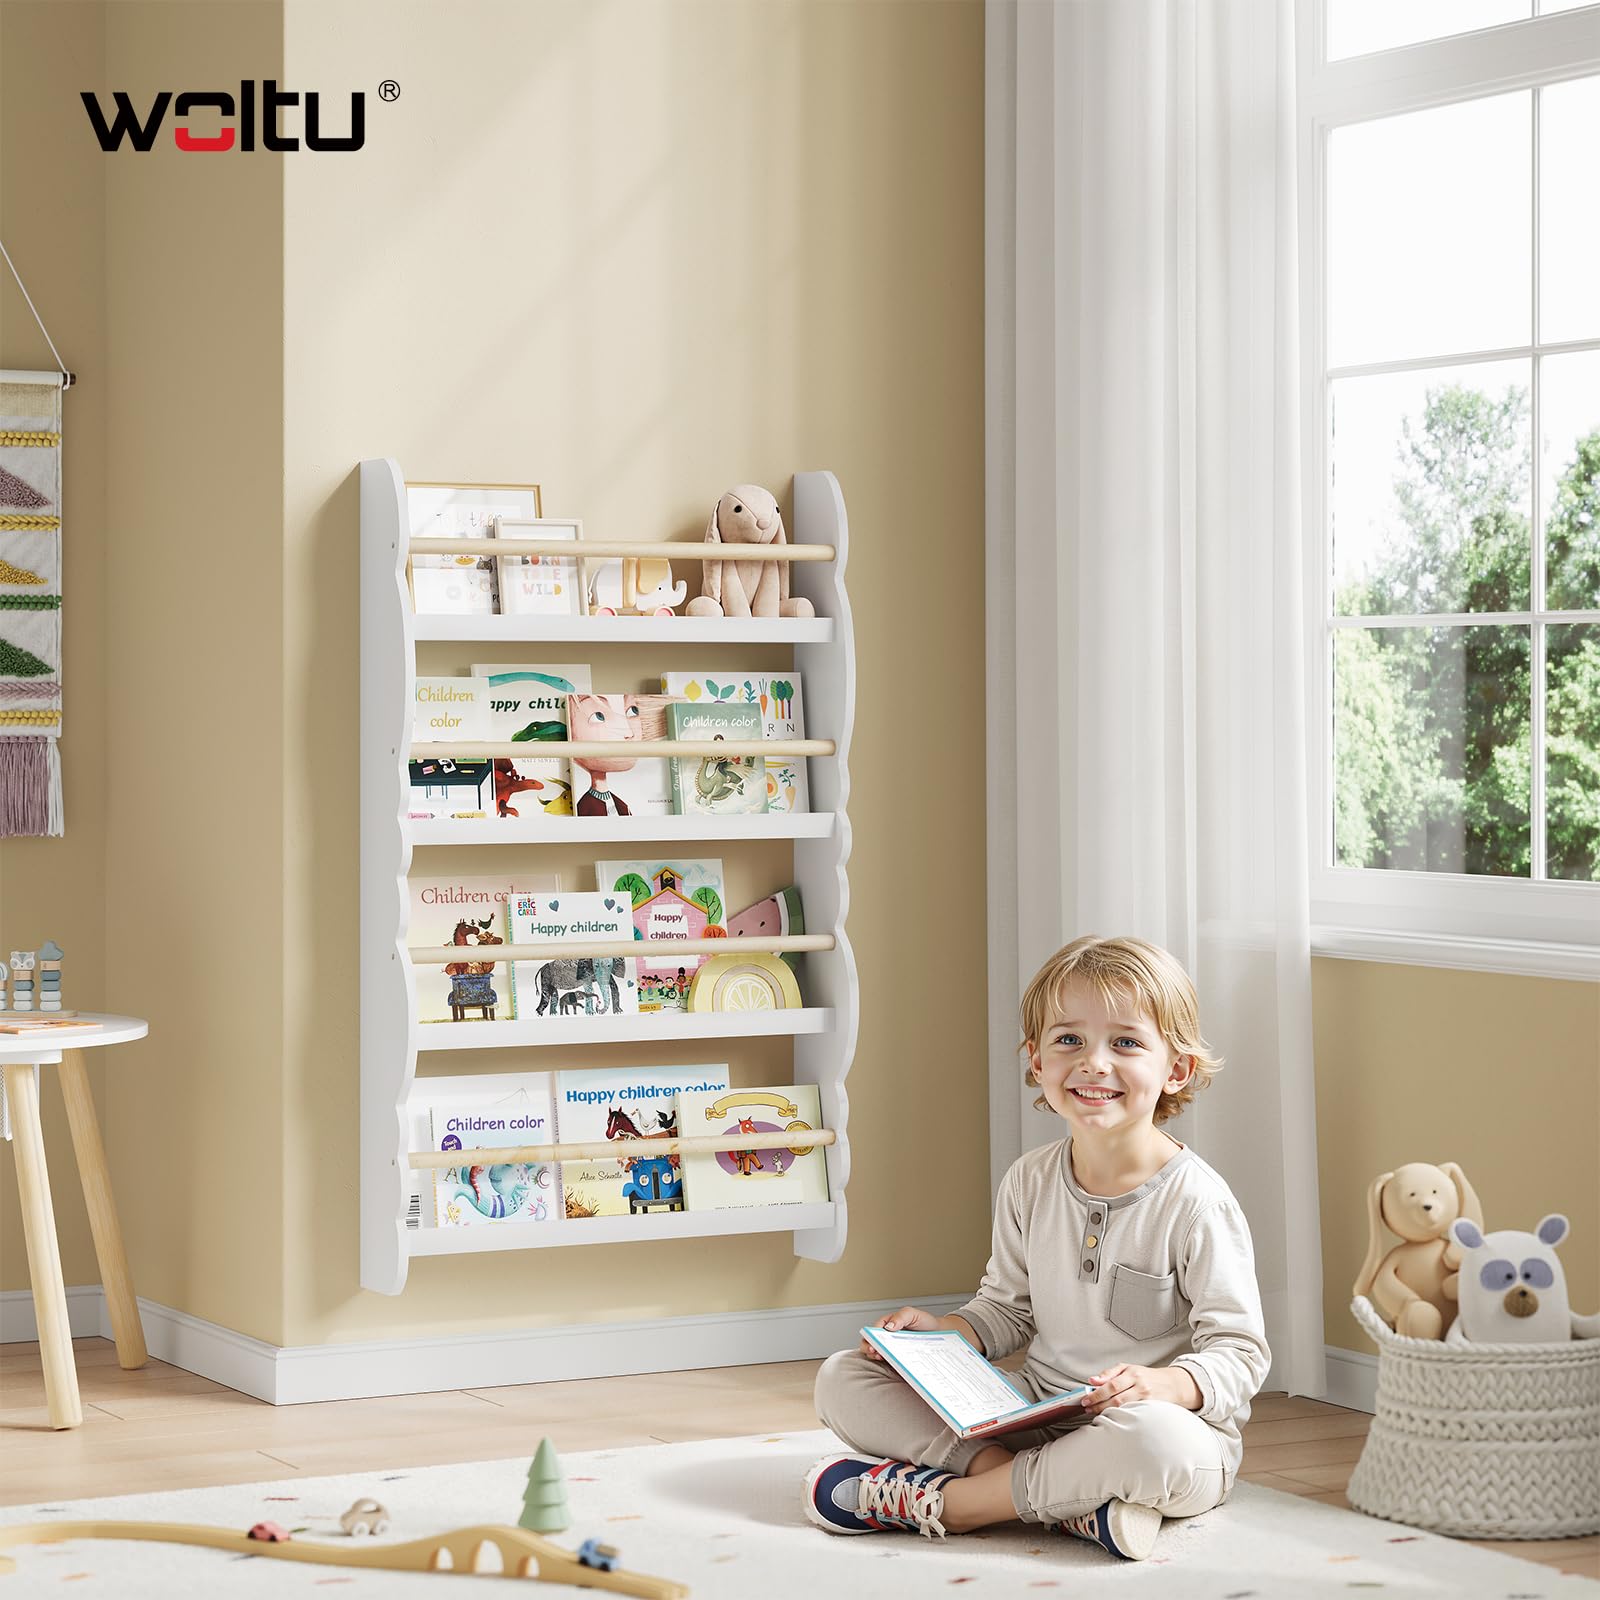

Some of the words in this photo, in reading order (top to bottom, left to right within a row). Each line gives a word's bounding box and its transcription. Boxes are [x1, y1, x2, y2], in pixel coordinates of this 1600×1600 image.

[417, 686, 474, 703] Children
[430, 712, 462, 728] color
[683, 715, 728, 729] Children
[731, 715, 757, 728] color
[421, 885, 492, 904] Children
[654, 914, 683, 923] Happy
[531, 922, 568, 937] Happy
[570, 921, 618, 933] children
[650, 931, 687, 940] children
[566, 1090, 615, 1105] Happy
[619, 1085, 682, 1100] children
[446, 1117, 505, 1131] Children
[509, 1115, 545, 1129] color
